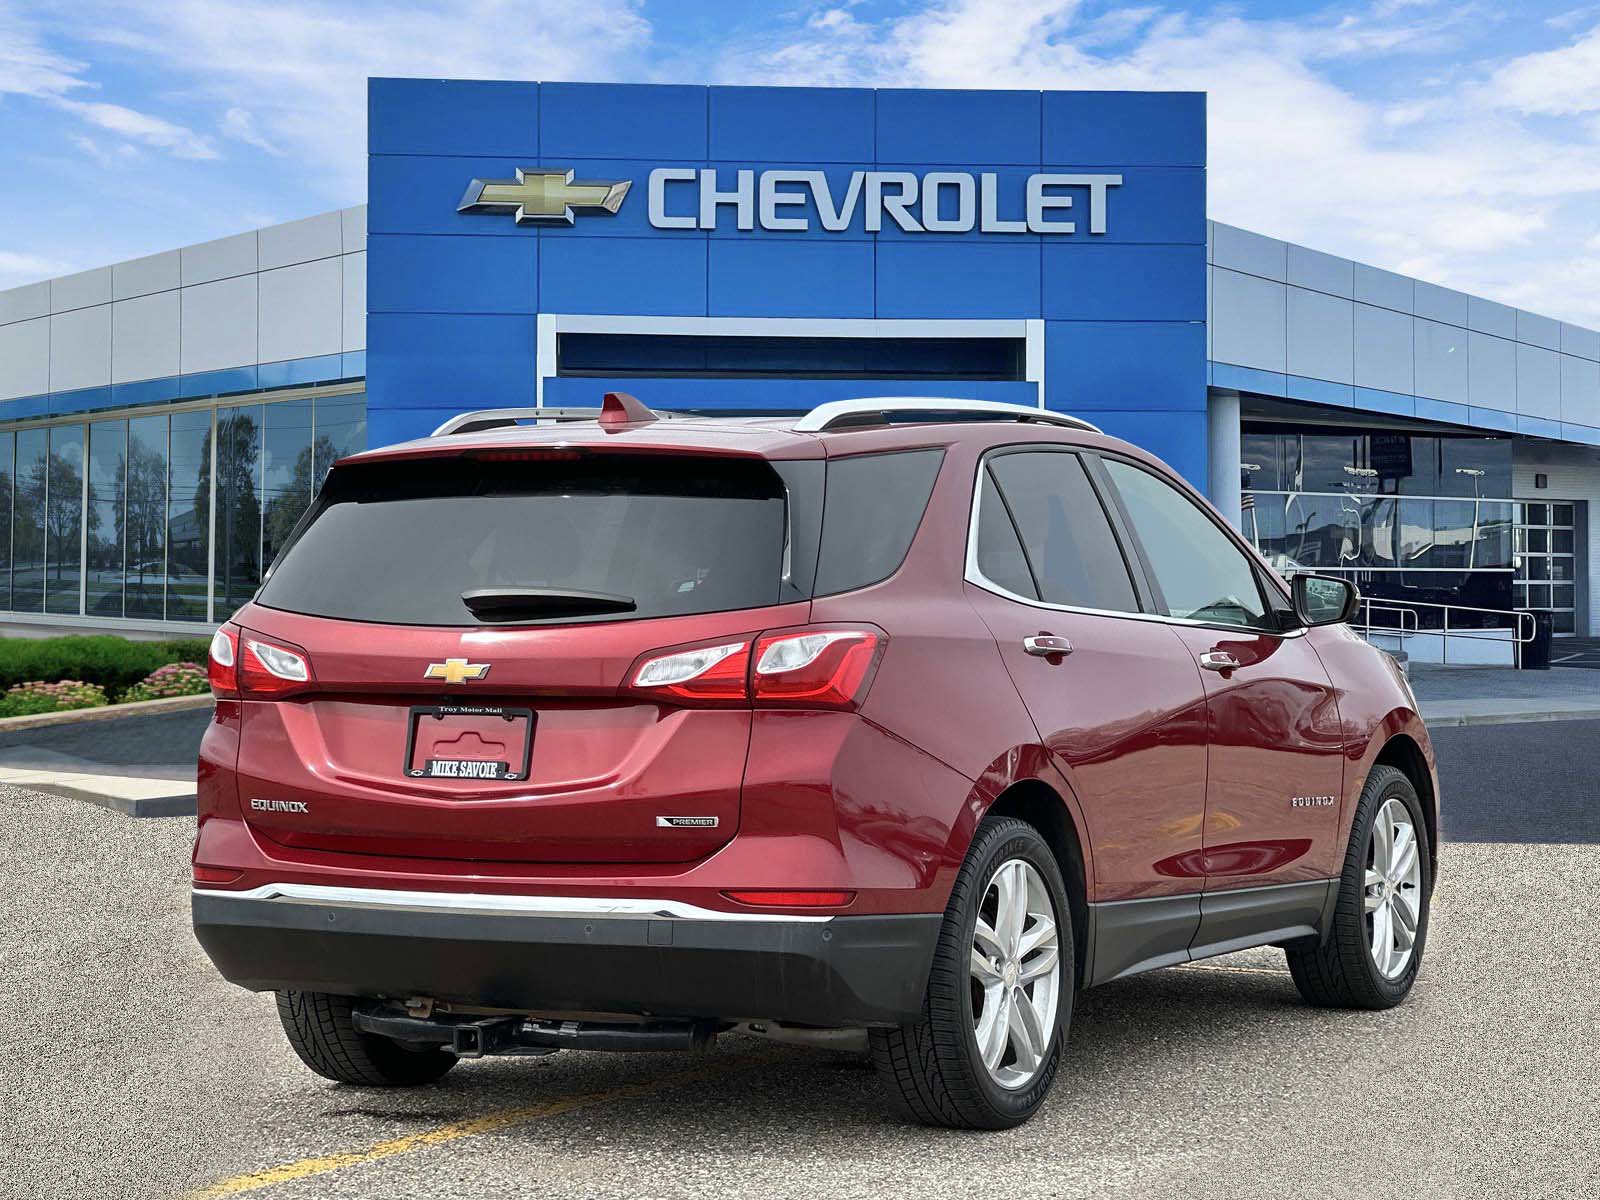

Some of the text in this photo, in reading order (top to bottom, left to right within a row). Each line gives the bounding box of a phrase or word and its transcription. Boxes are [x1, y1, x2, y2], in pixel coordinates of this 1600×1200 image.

[648, 167, 1123, 234] CHEVROLET
[439, 705, 457, 713] Troy
[460, 706, 483, 714] Motor
[430, 760, 498, 779] MIKE SAVOIE
[250, 798, 309, 813] EQUINOX
[1292, 796, 1335, 807] EQUINOX
[672, 818, 714, 826] PREMIER
